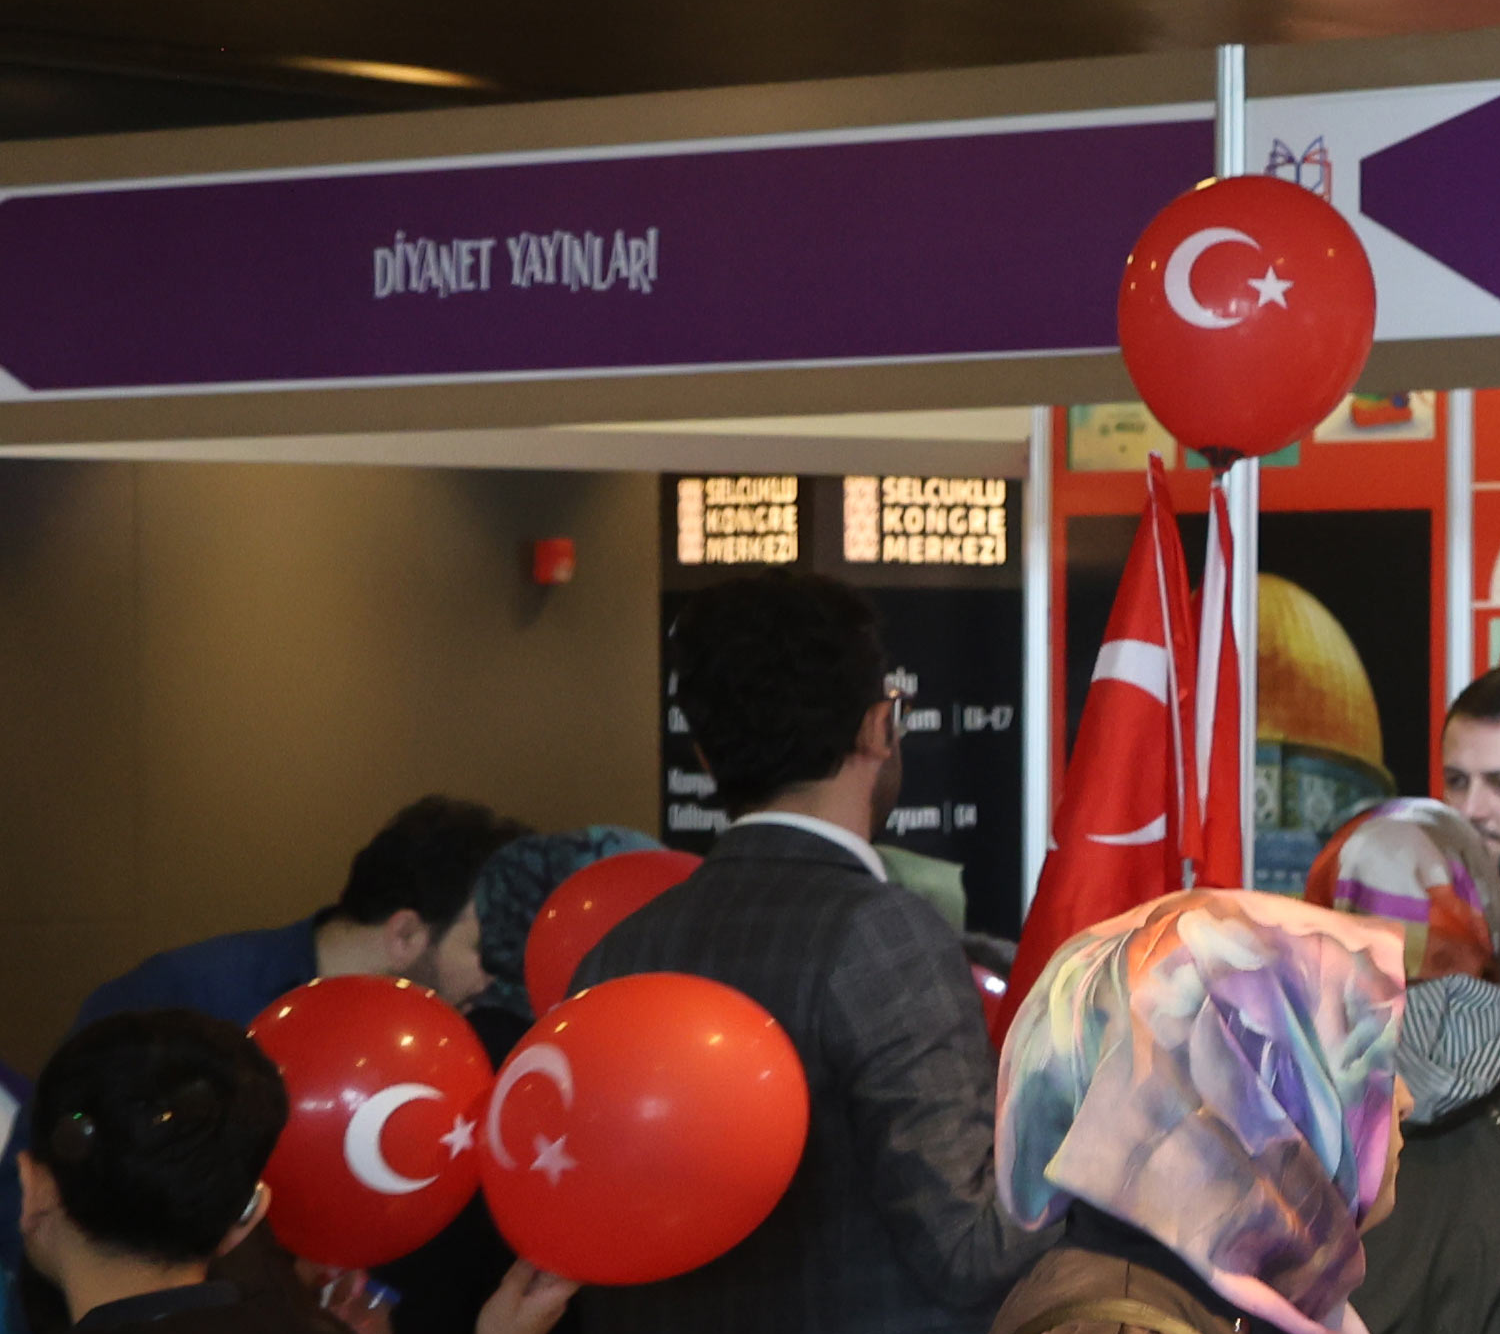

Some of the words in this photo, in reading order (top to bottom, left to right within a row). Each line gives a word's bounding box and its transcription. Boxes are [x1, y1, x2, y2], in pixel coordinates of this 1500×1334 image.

[373, 230, 496, 298] DİYANET
[508, 226, 659, 294] YAYINLARI
[882, 476, 1006, 507] SELÇUKLU
[883, 507, 1006, 535] KONGRE
[883, 533, 1006, 565] MERKEZİ
